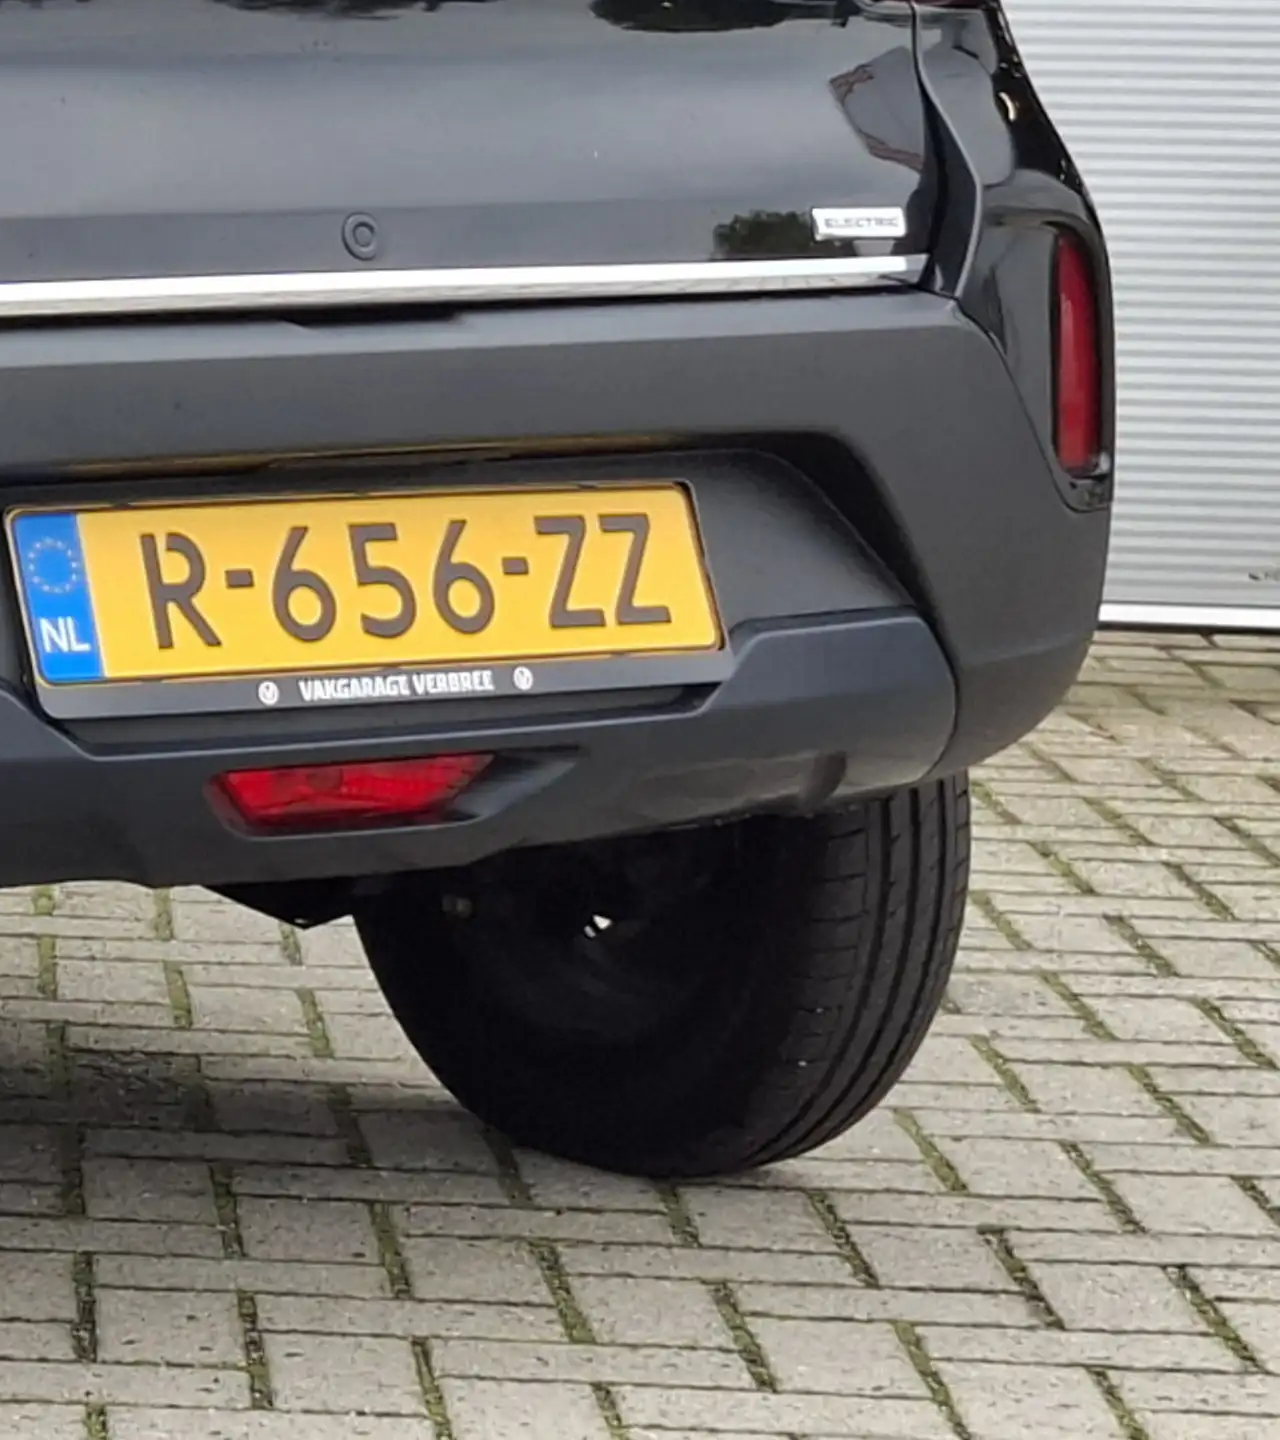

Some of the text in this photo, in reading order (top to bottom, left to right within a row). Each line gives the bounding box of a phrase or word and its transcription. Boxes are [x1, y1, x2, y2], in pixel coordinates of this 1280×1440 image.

[139, 511, 673, 650] R-656-ZZ
[39, 616, 92, 654] NL
[298, 669, 495, 702] VAKGARAGE VERBREE
